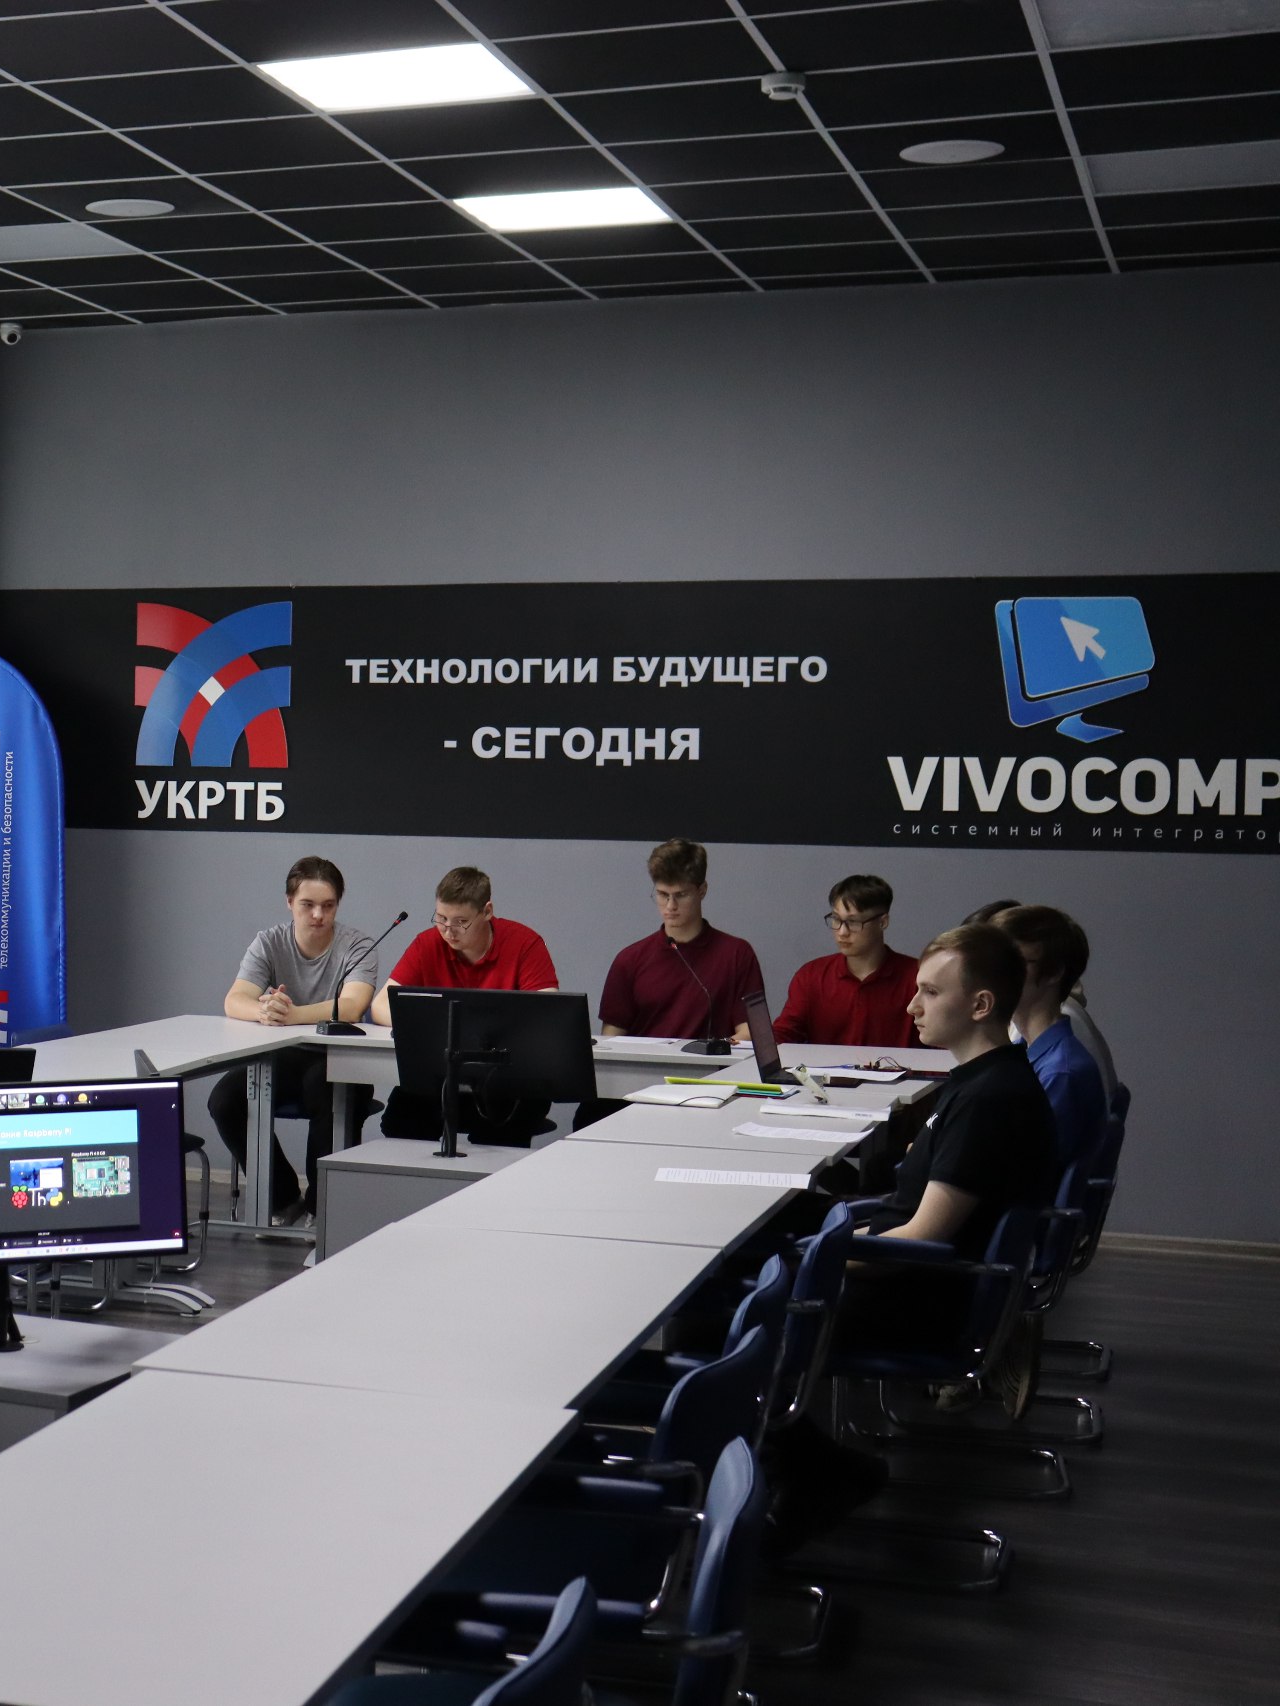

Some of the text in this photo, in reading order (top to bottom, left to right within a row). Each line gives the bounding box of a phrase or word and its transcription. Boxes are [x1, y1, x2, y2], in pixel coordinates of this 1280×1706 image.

[344, 655, 828, 688] ТЕХНОЛОГИИ БУДУЩЕГО
[471, 726, 700, 767] СЕГОДНЯ
[134, 779, 286, 822] УКРТБ
[886, 755, 1280, 816] VIVOCOMP
[892, 823, 1280, 844] системный интеграто
[0, 751, 14, 970] телекоммуникации и безопасности
[23, 1128, 63, 1139] Raspberry
